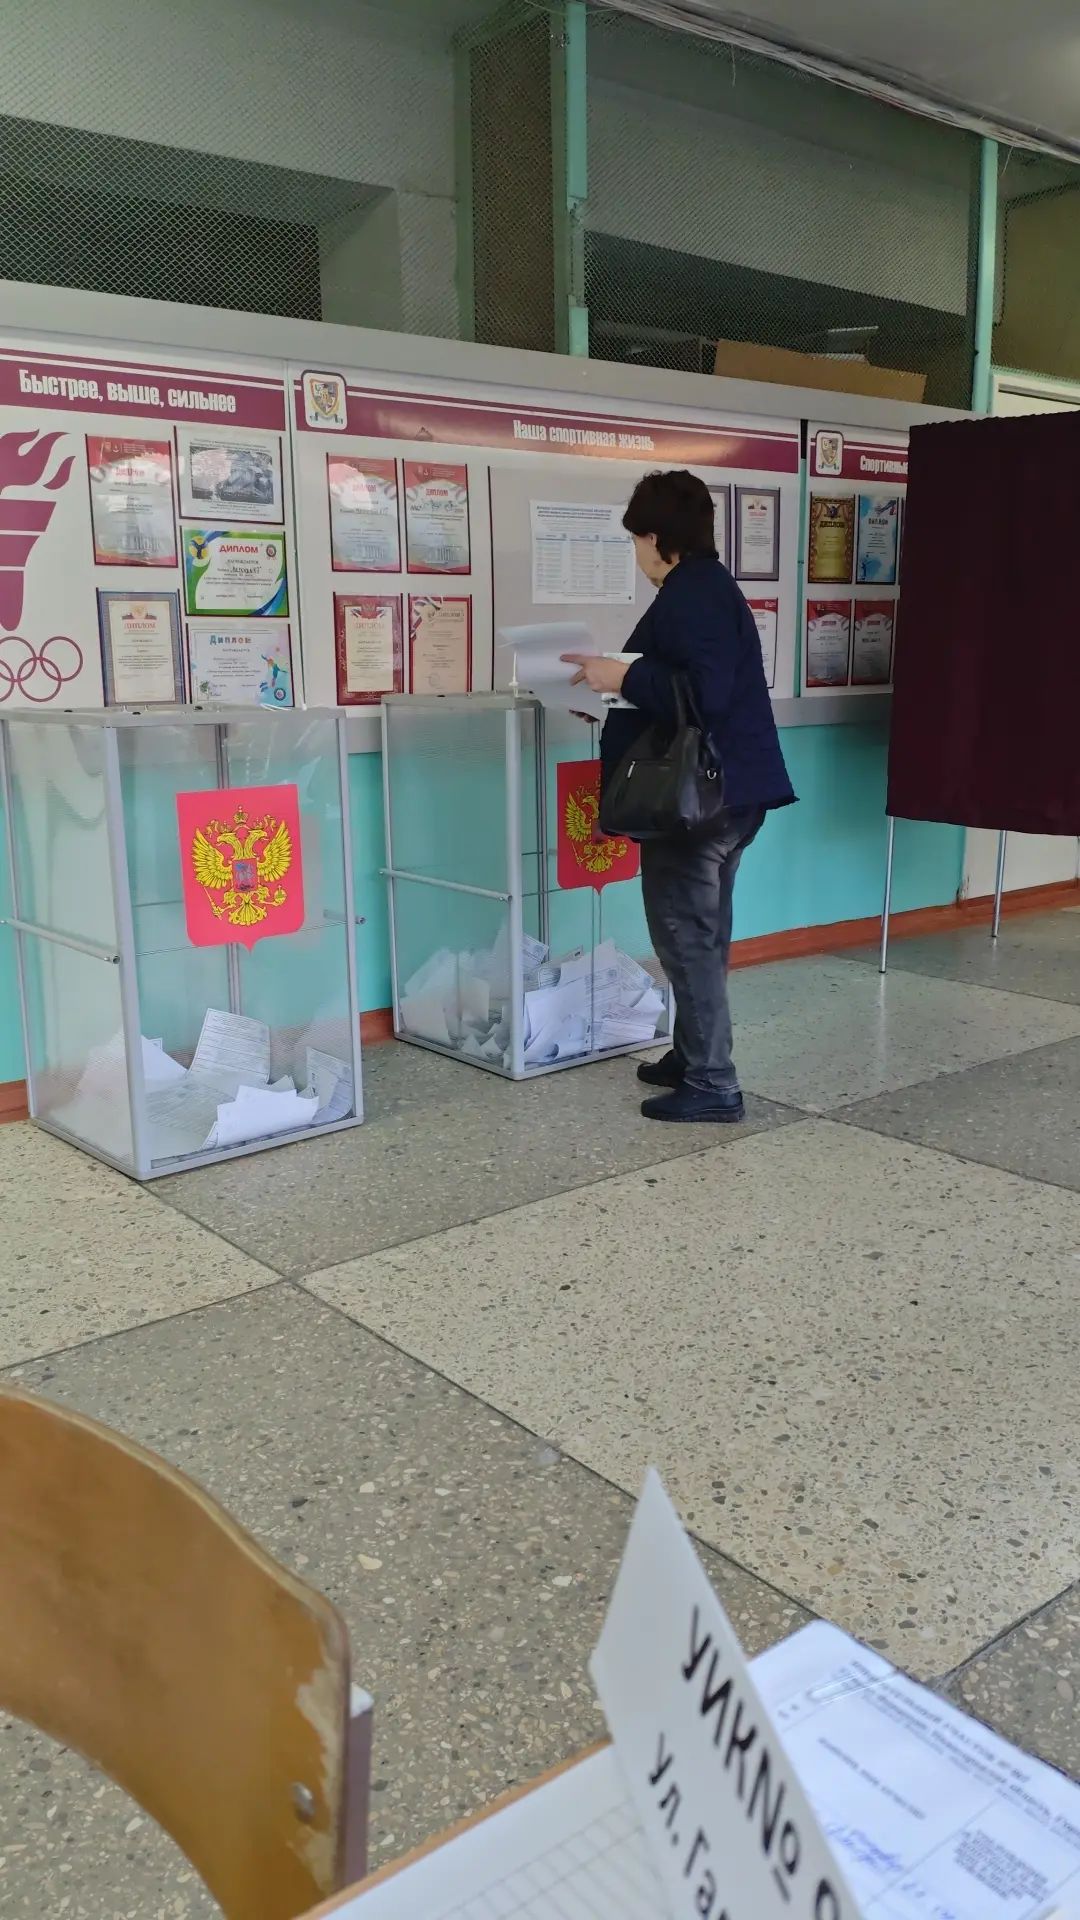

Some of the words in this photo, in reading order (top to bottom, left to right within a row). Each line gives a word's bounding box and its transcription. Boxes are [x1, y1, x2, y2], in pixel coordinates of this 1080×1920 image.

[18, 369, 104, 402] Быстрее,
[107, 382, 165, 408] выше,
[167, 388, 236, 413] сильнее
[513, 419, 547, 441] Наша
[549, 426, 617, 448] спортивная
[618, 433, 655, 451] жизнь
[219, 545, 259, 554] ДИПЛОМ
